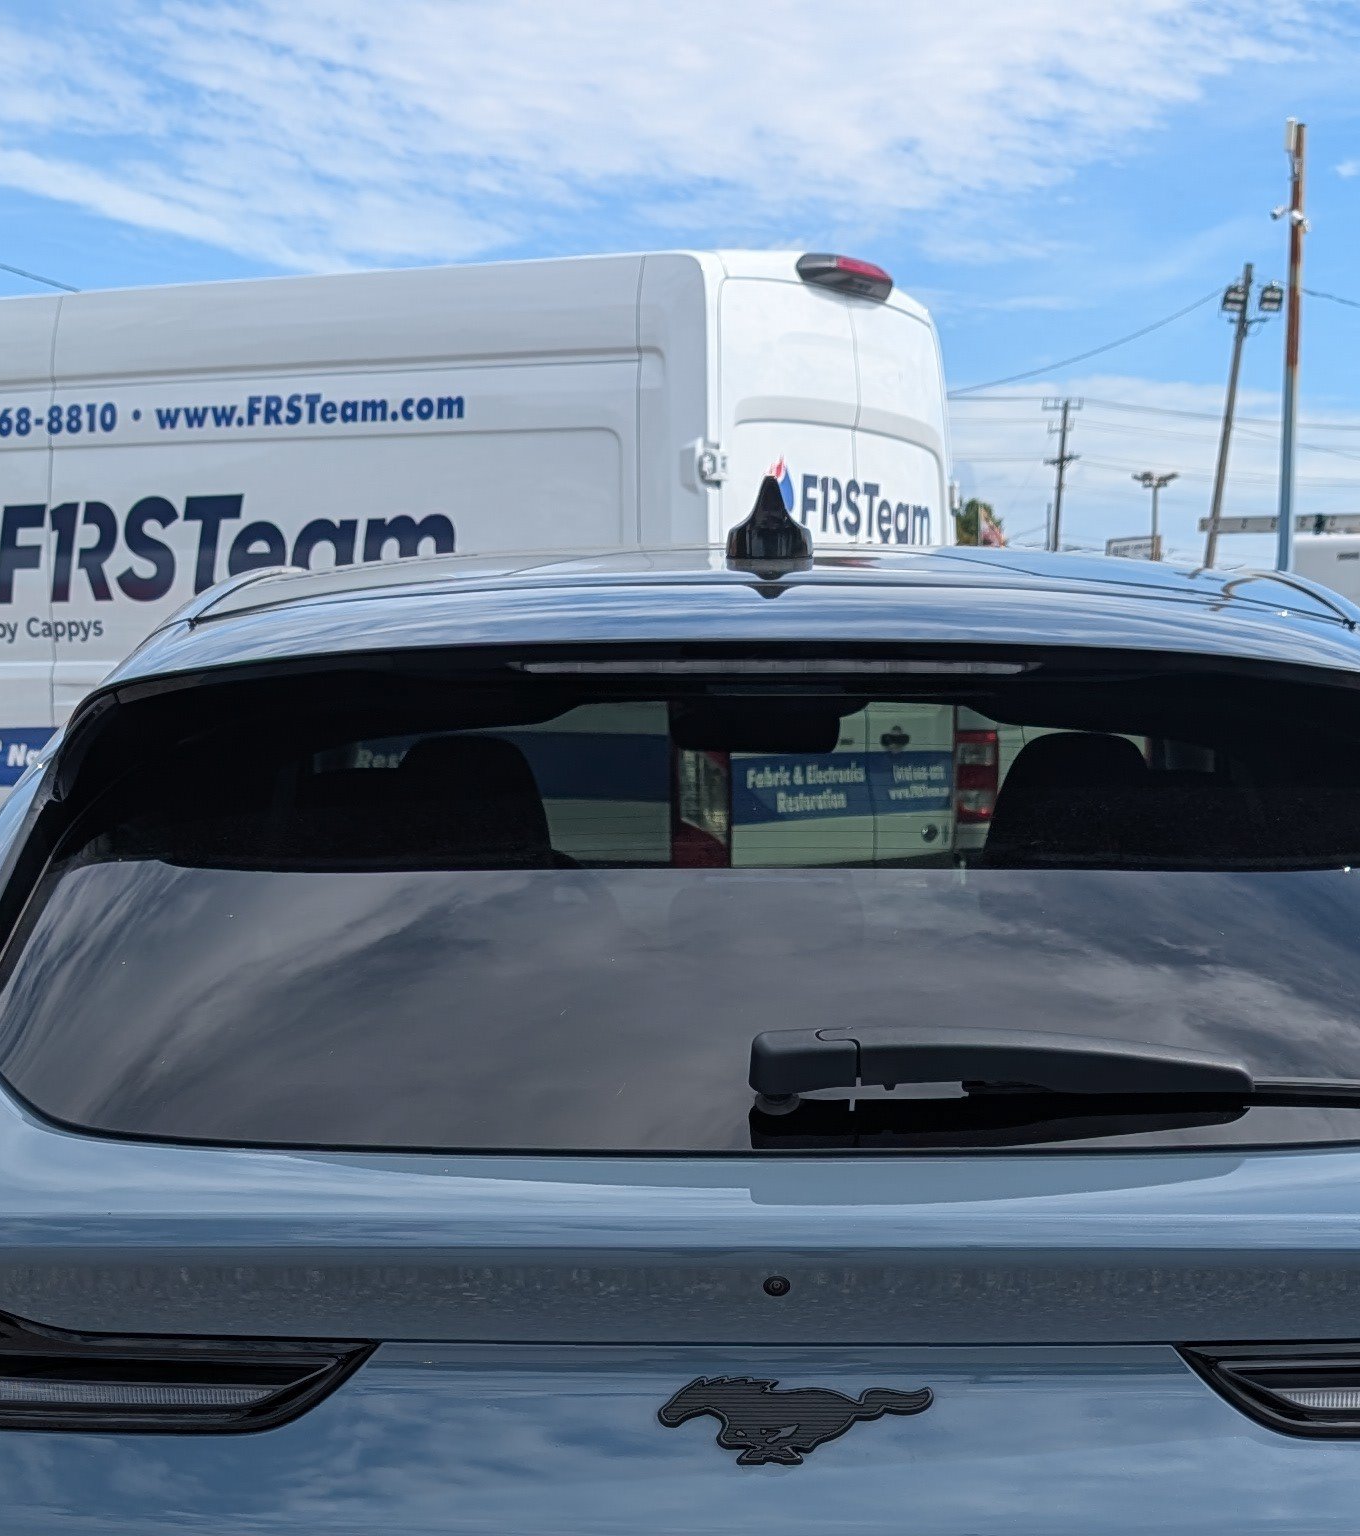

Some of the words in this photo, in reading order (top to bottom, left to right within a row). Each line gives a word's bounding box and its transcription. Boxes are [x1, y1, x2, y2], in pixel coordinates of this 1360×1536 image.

[156, 393, 466, 430] www.FRSTeam.com
[26, 616, 105, 642] Cappys
[354, 748, 408, 769] Res
[746, 763, 791, 790] Fabric
